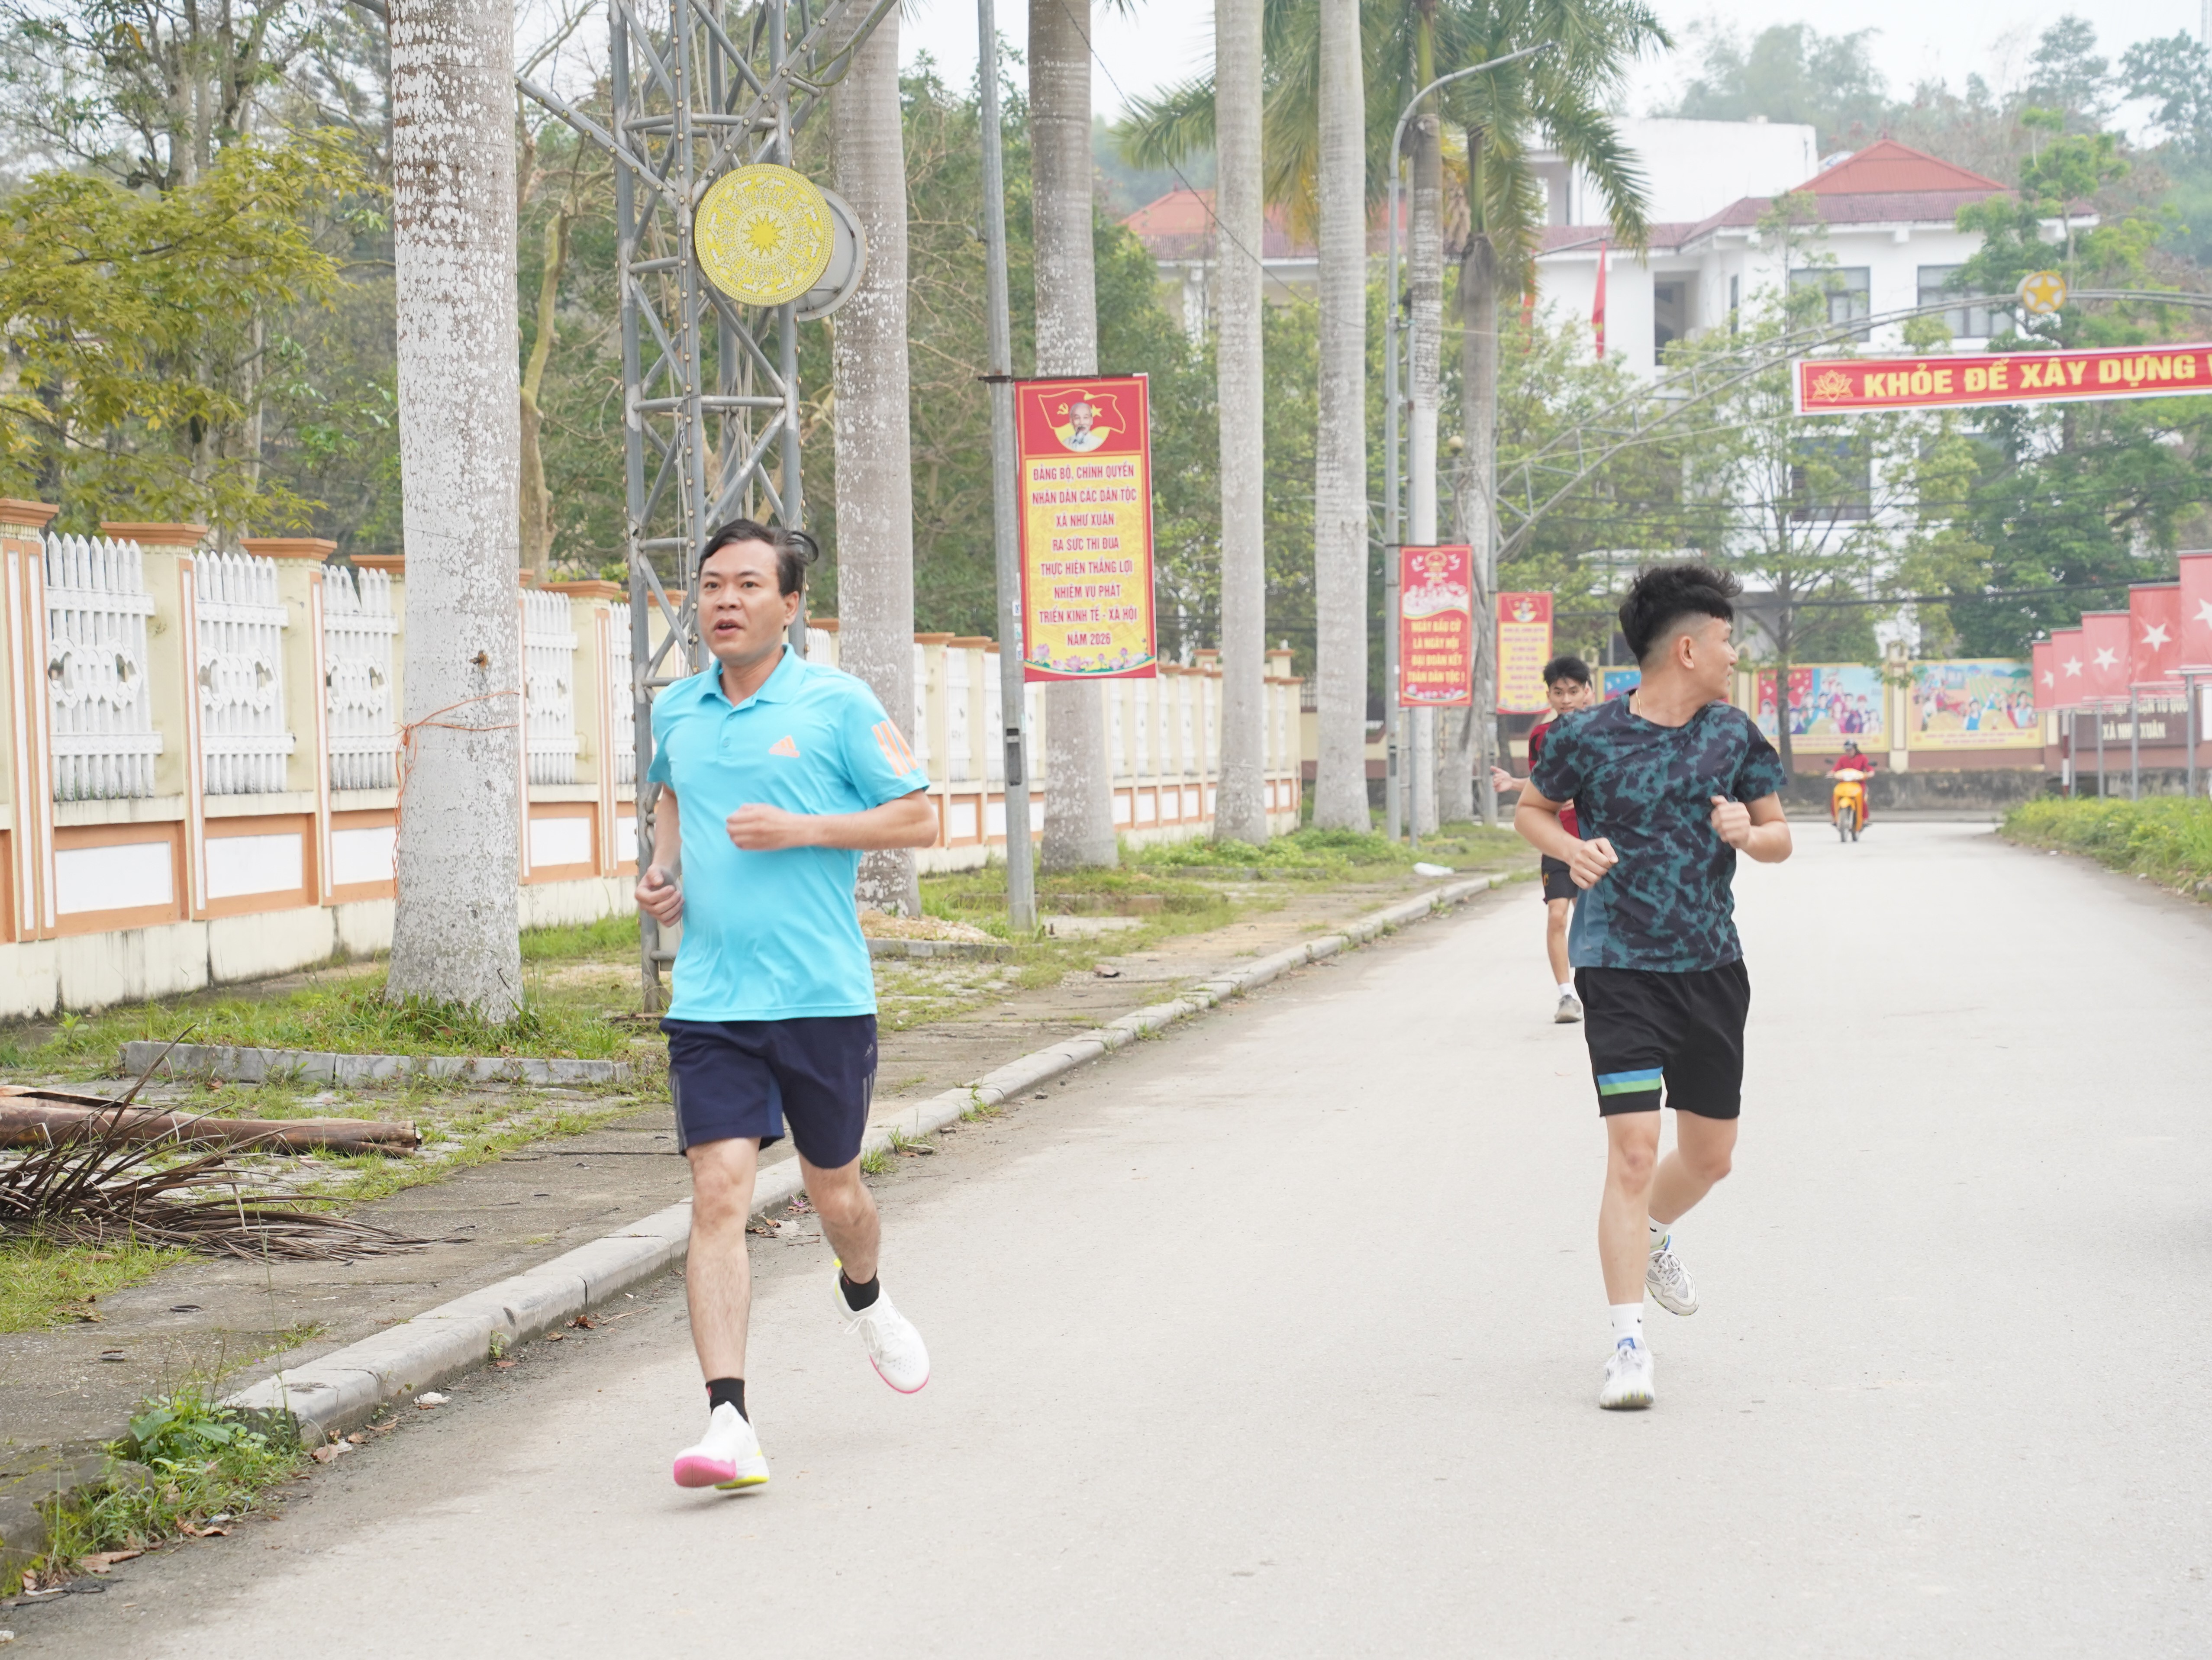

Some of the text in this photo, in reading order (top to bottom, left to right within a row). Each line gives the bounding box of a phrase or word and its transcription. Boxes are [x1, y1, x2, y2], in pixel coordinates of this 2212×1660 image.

[1864, 363, 1953, 398] KHỎE
[1964, 358, 2009, 392] ĐỂ
[2020, 357, 2088, 389] XÂY
[2099, 355, 2196, 387] DỰNG
[1034, 464, 1057, 480] ĐẢNG
[1061, 464, 1074, 482] BỘ,
[1077, 463, 1103, 478] CHÍNH
[1032, 486, 1136, 504] NHÂN DÂN CÁC DÂN TỘC
[1056, 511, 1114, 527] XÃ NHƯ XUÂN
[1053, 536, 1119, 551] RA SỨC THI ĐUA
[1041, 556, 1132, 577] THỰC HIỆN THẮNG LỢI
[1054, 582, 1121, 601] NHIỆM VỤ PHÁT
[1067, 610, 1087, 622] KINH
[1090, 605, 1100, 621] TẾ
[1109, 605, 1120, 620] XÃ
[1123, 606, 1137, 623] HỘI
[1067, 631, 1110, 645] NĂM 2026
[2117, 722, 2133, 740] NH
